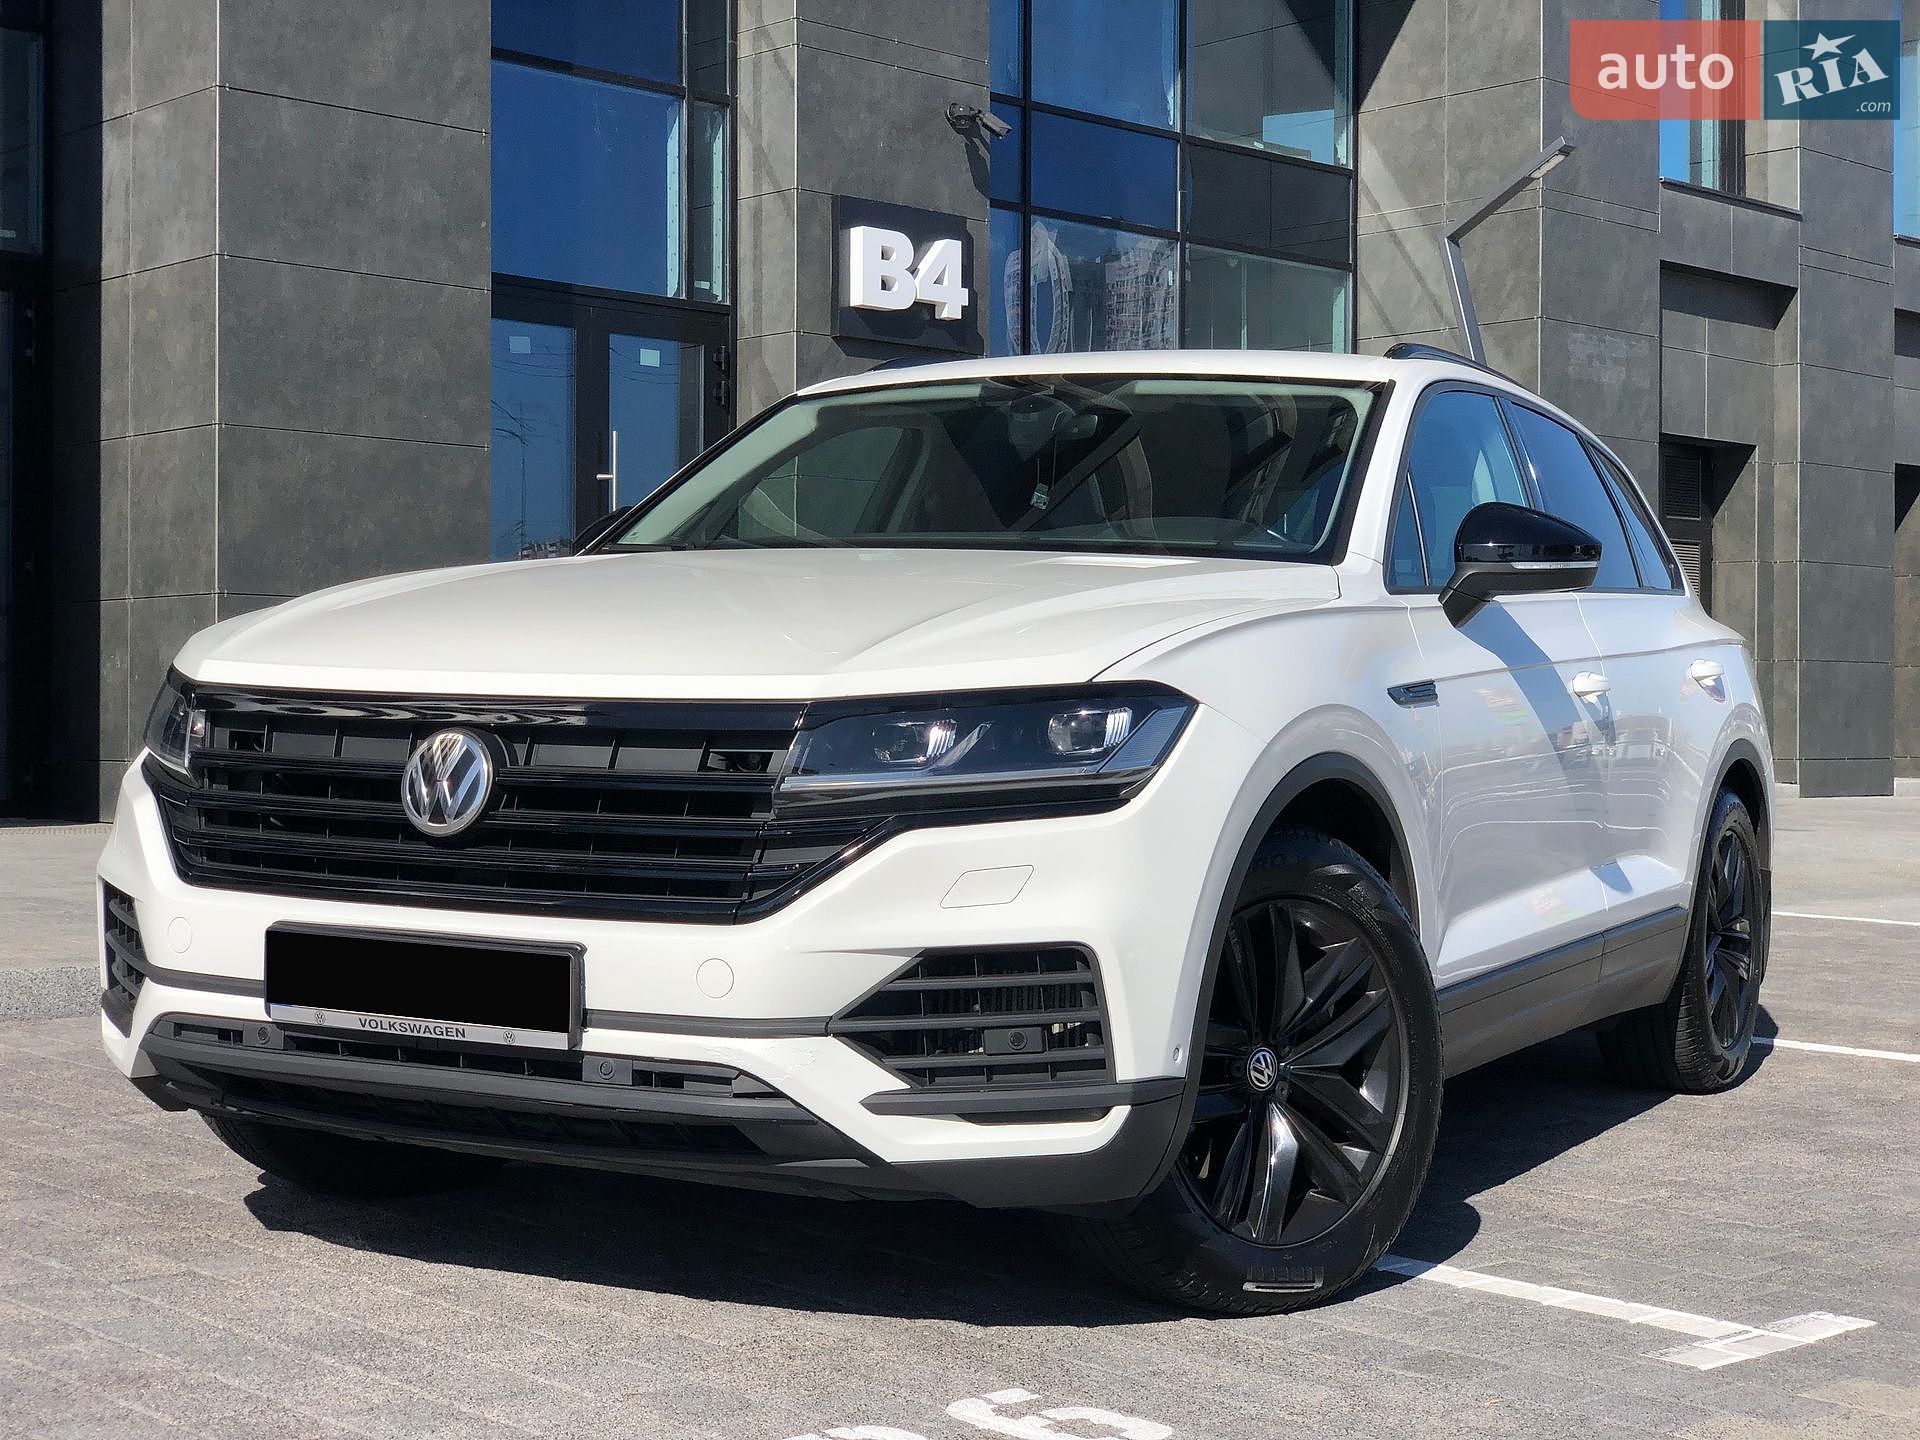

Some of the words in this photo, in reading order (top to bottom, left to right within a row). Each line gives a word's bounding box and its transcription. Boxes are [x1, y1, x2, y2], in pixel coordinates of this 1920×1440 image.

[850, 225, 969, 321] B4
[358, 1017, 467, 1040] VOLKSWAGEN
[779, 1388, 1173, 1440] 6
